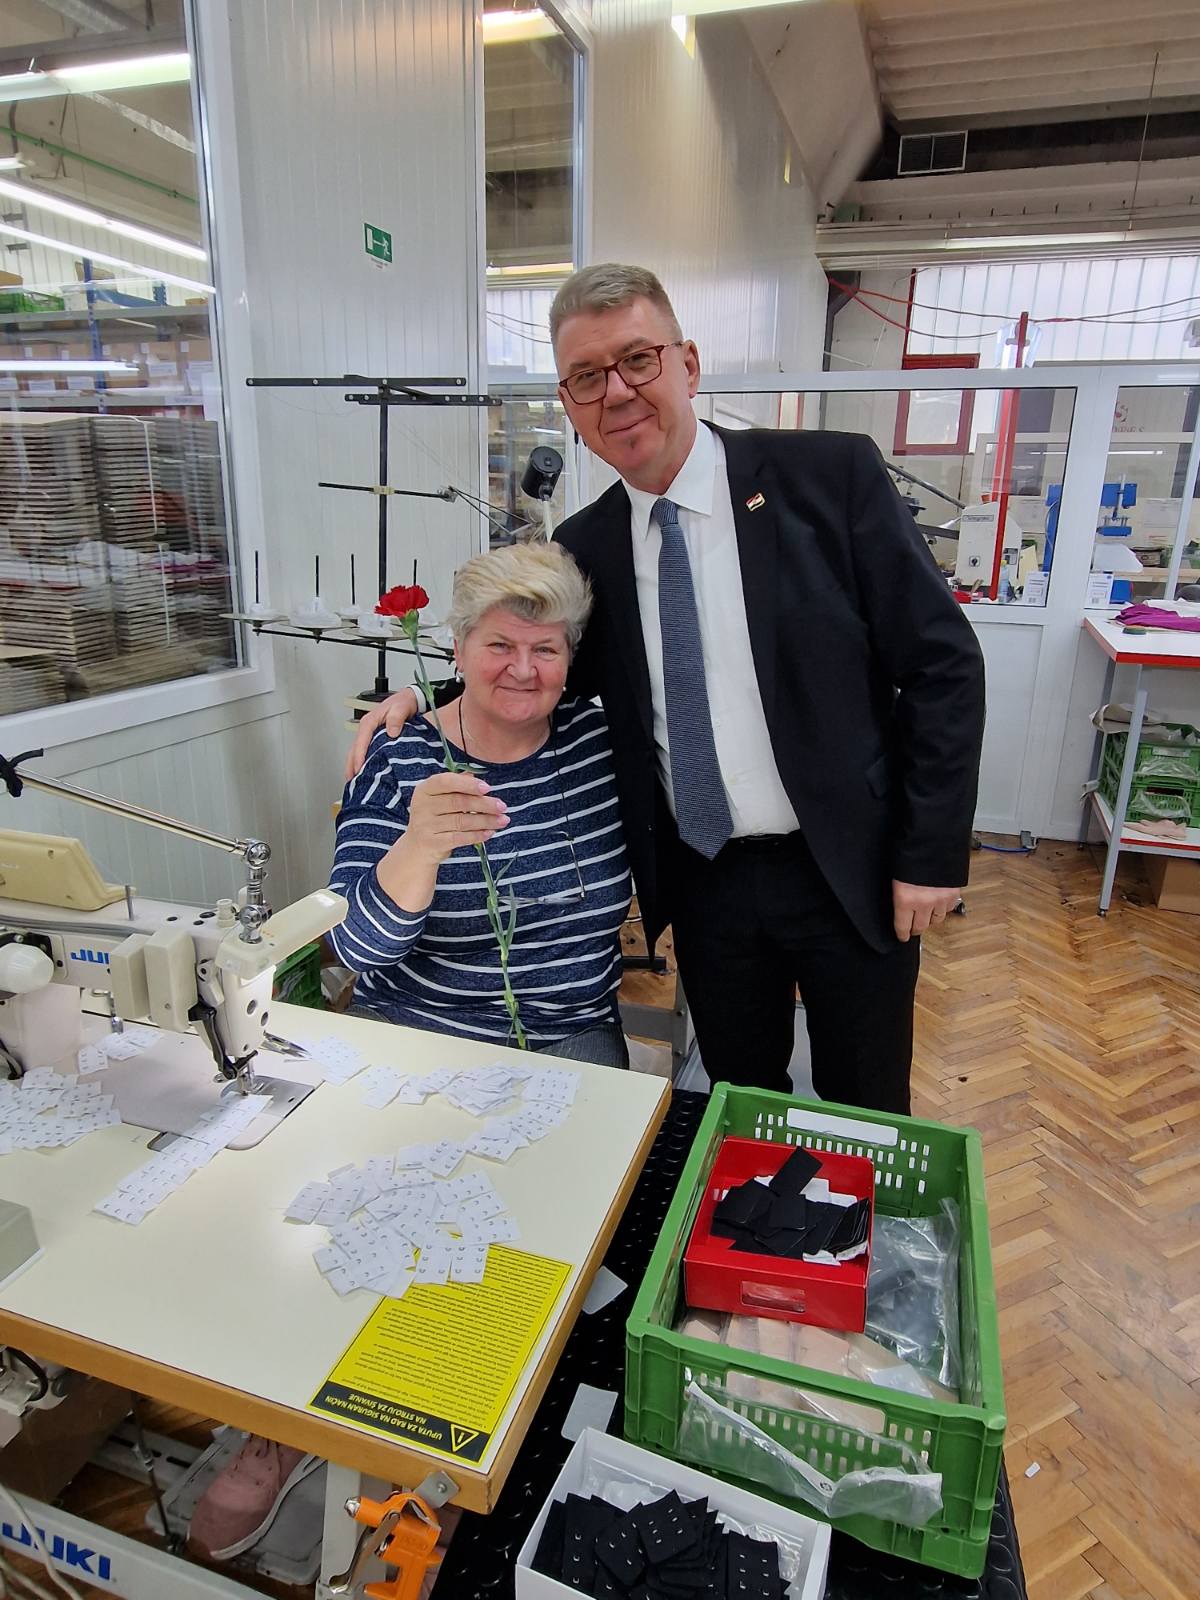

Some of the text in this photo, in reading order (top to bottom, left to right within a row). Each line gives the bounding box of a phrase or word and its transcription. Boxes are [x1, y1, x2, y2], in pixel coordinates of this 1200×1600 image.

[70, 948, 110, 965] JU
[346, 1403, 380, 1419] SIGURAN
[348, 1393, 427, 1425] NA STROJU ZA ŠIVANJE
[379, 1413, 391, 1423] NA
[390, 1417, 407, 1428] RAD
[406, 1422, 418, 1432] ZA
[417, 1426, 443, 1440] UPUTA
[2, 1522, 111, 1580] JUKI
